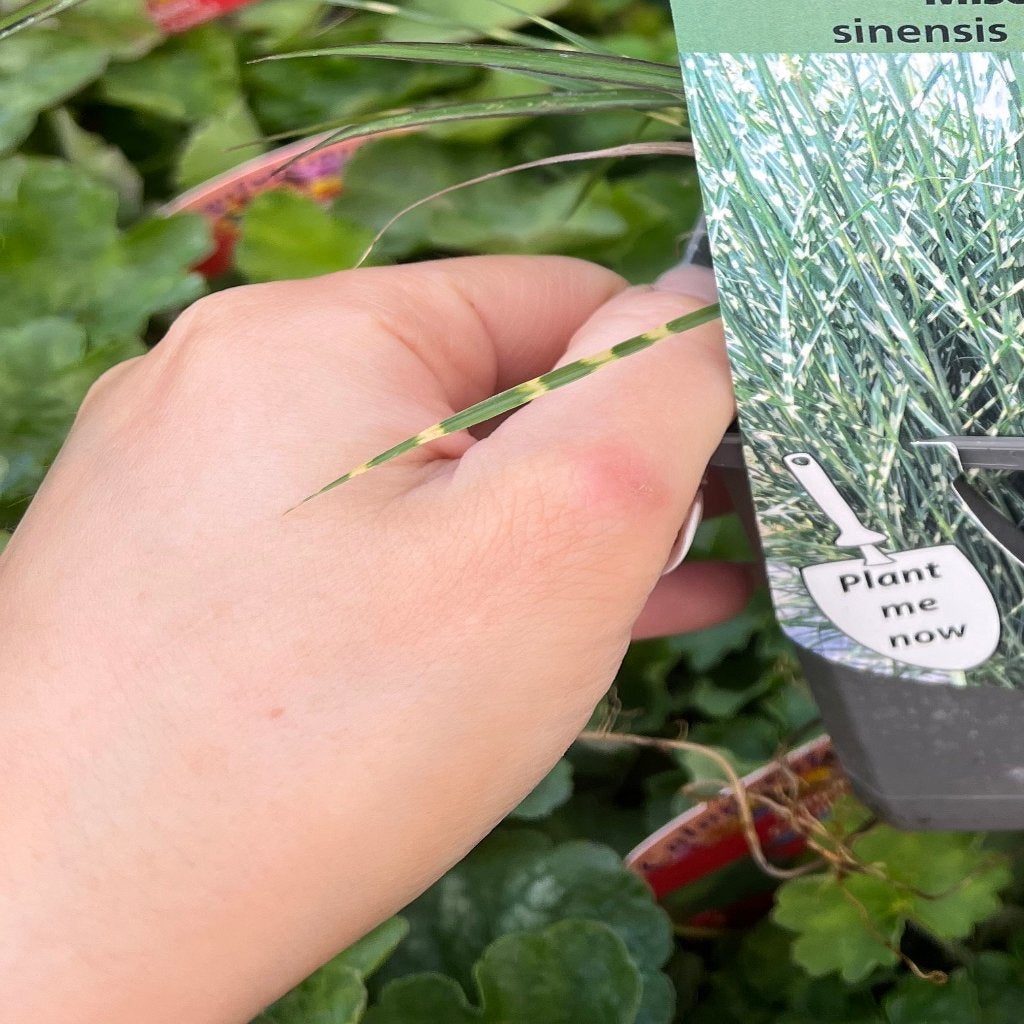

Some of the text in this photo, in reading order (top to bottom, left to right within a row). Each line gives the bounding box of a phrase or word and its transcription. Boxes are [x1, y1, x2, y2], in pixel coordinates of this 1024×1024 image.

[833, 17, 1008, 44] sinensis
[839, 562, 942, 593] Plant
[881, 597, 938, 619] me
[889, 623, 967, 648] now
